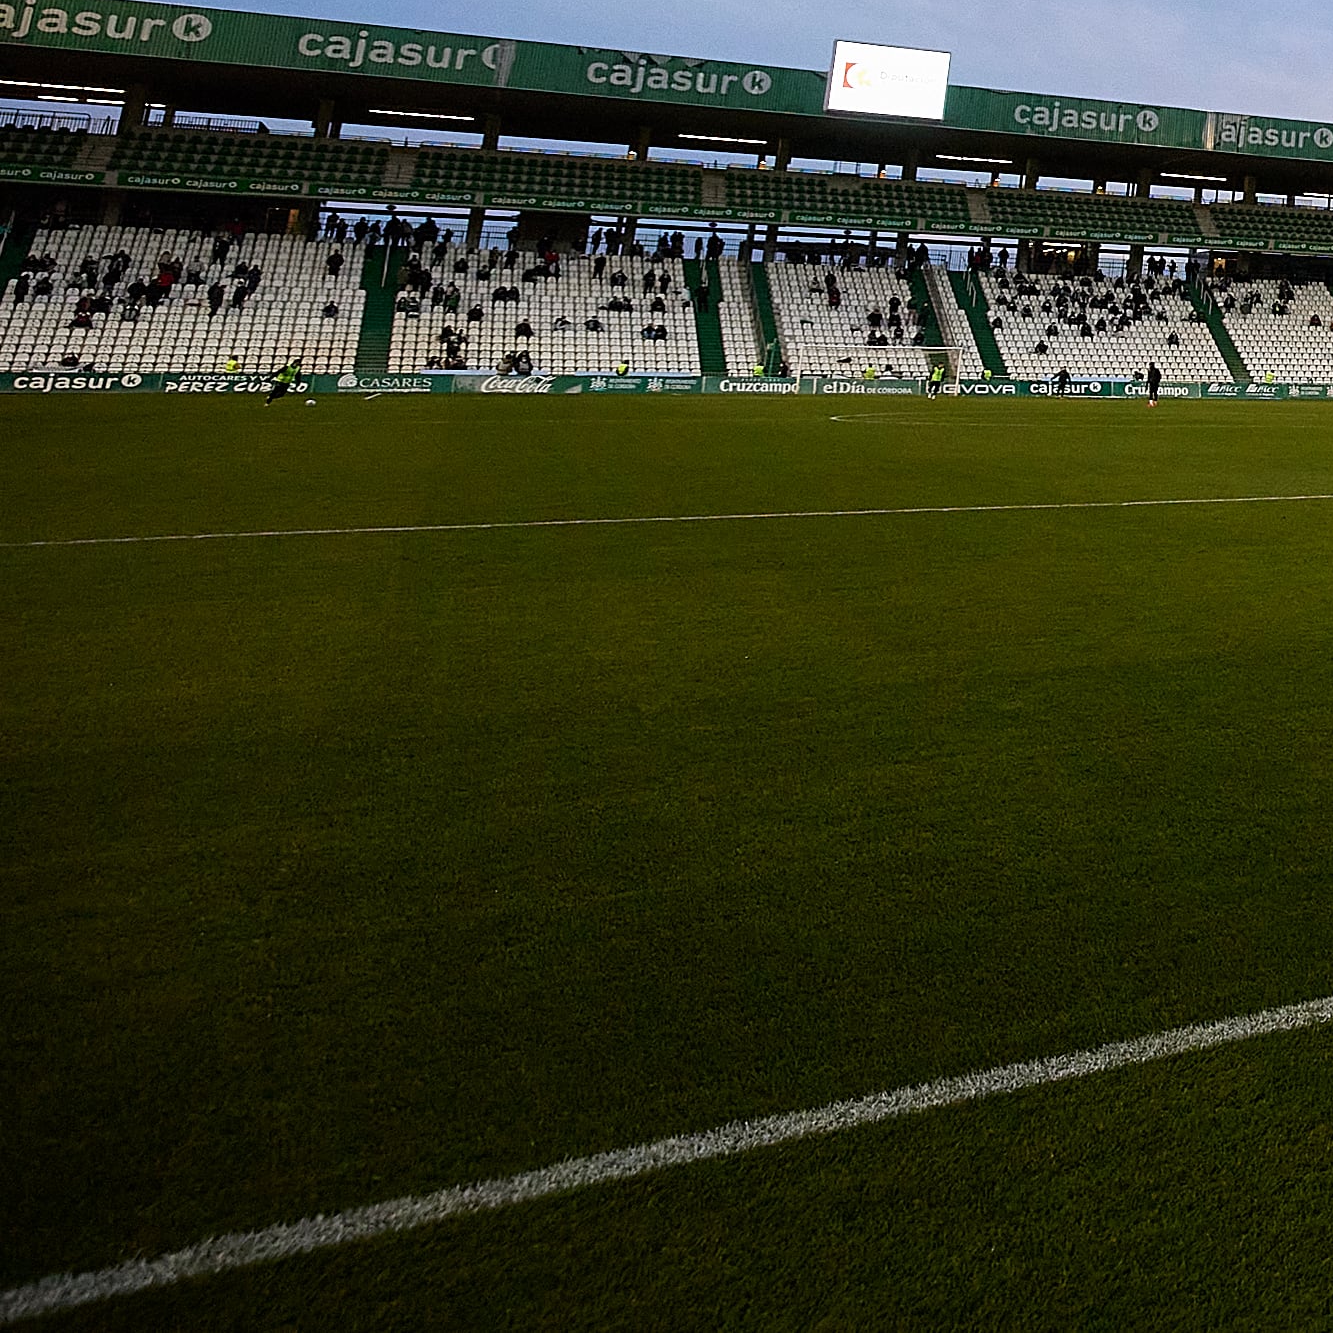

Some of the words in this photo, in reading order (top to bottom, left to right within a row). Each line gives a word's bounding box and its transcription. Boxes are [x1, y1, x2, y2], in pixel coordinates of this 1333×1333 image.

[298, 30, 477, 70] cajasur
[586, 55, 738, 95] cajasur
[1014, 103, 1131, 132] cajasur
[40, 170, 85, 181] cajasur
[128, 174, 171, 185] cajasur
[186, 178, 229, 189] cajasur
[249, 182, 291, 191] cajasur
[318, 186, 359, 196] cajasur
[372, 189, 412, 199] cajasur
[425, 192, 464, 202] cajasur
[492, 196, 528, 205] cajasur
[542, 199, 577, 208] cajasur
[590, 202, 625, 211] cajasur
[649, 205, 681, 214] cajasur
[694, 208, 725, 217] cajasur
[737, 210, 768, 219] cajasur
[796, 214, 826, 223] cajasur
[837, 217, 866, 225] cajasur
[876, 220, 905, 228] cajasur
[14, 376, 118, 392] cajasur
[359, 377, 432, 388] CASARES
[720, 379, 799, 394] Cruzcampo
[942, 384, 1015, 394] GIVOVA
